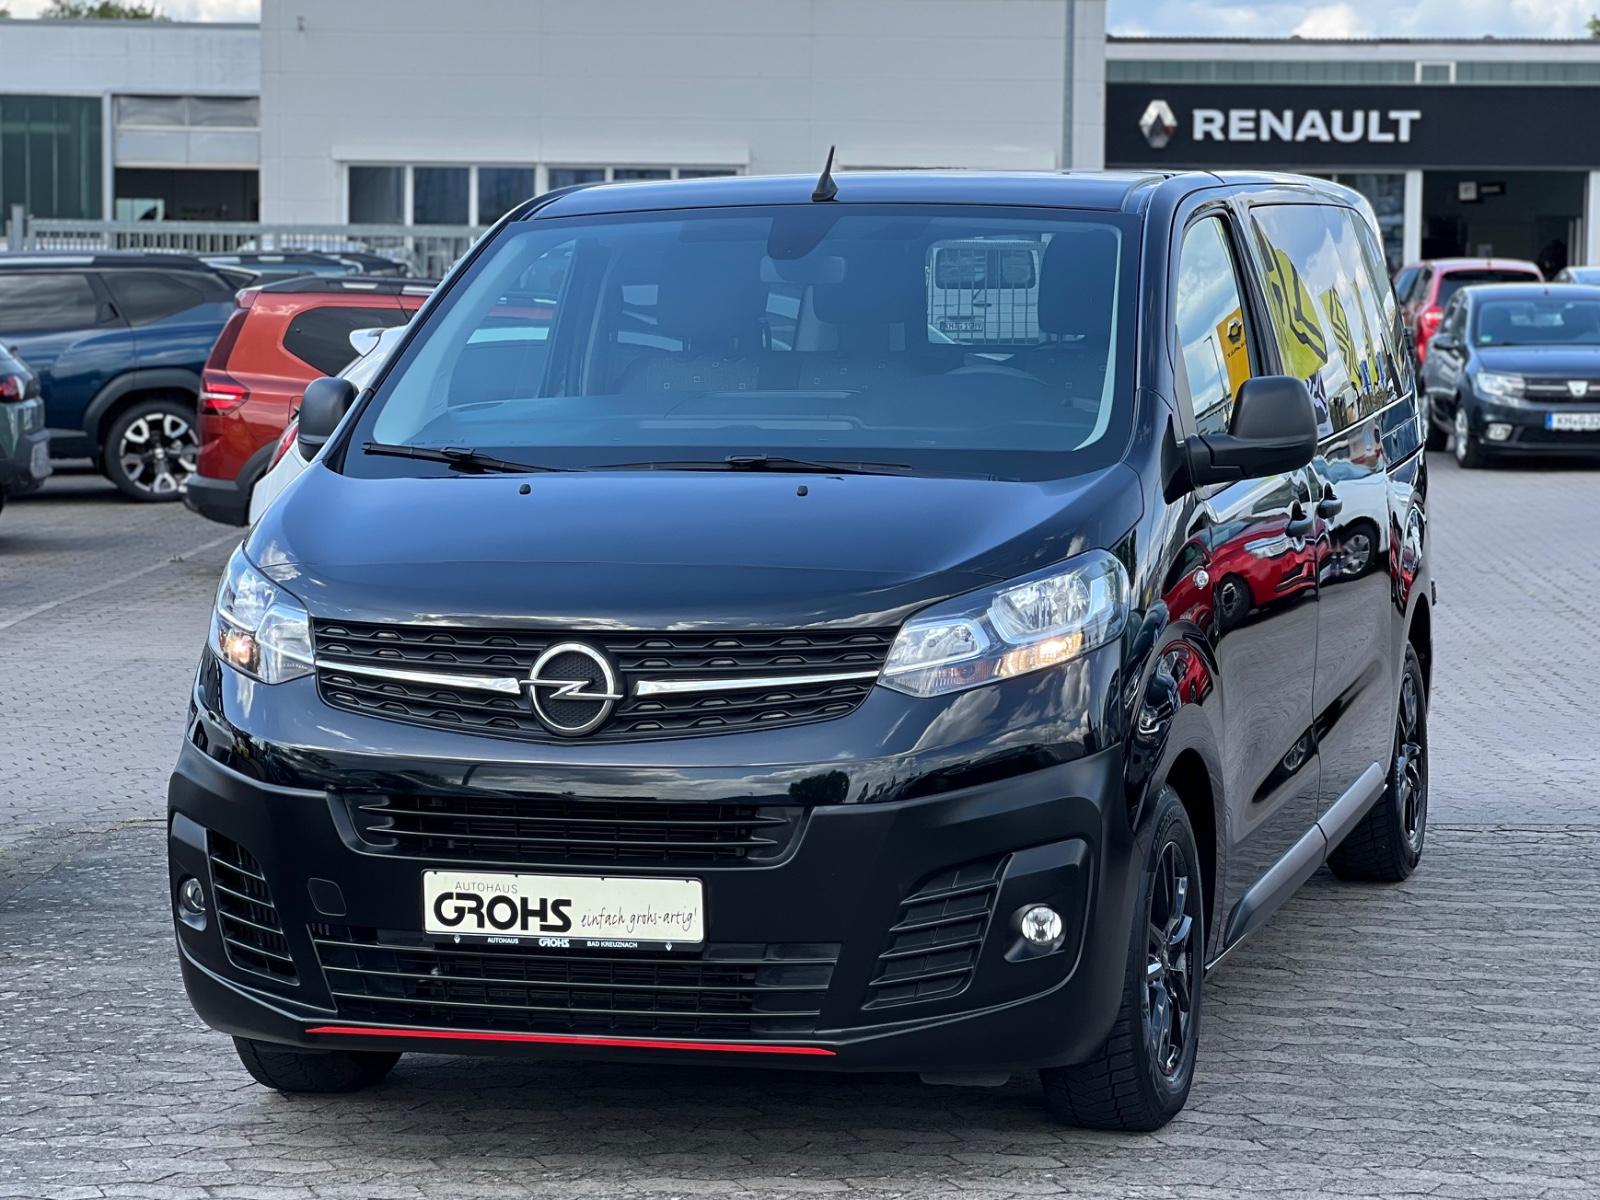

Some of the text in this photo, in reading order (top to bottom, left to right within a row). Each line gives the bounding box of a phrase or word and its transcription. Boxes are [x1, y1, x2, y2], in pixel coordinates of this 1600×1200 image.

[1192, 108, 1422, 143] RENAULT
[455, 881, 519, 895] AUTOHAUS
[433, 891, 573, 933] GROHS
[580, 904, 697, 934] einfach grohs-artig!
[487, 937, 638, 949] AUTOHAUS GROHS BAD KREUZNACH
